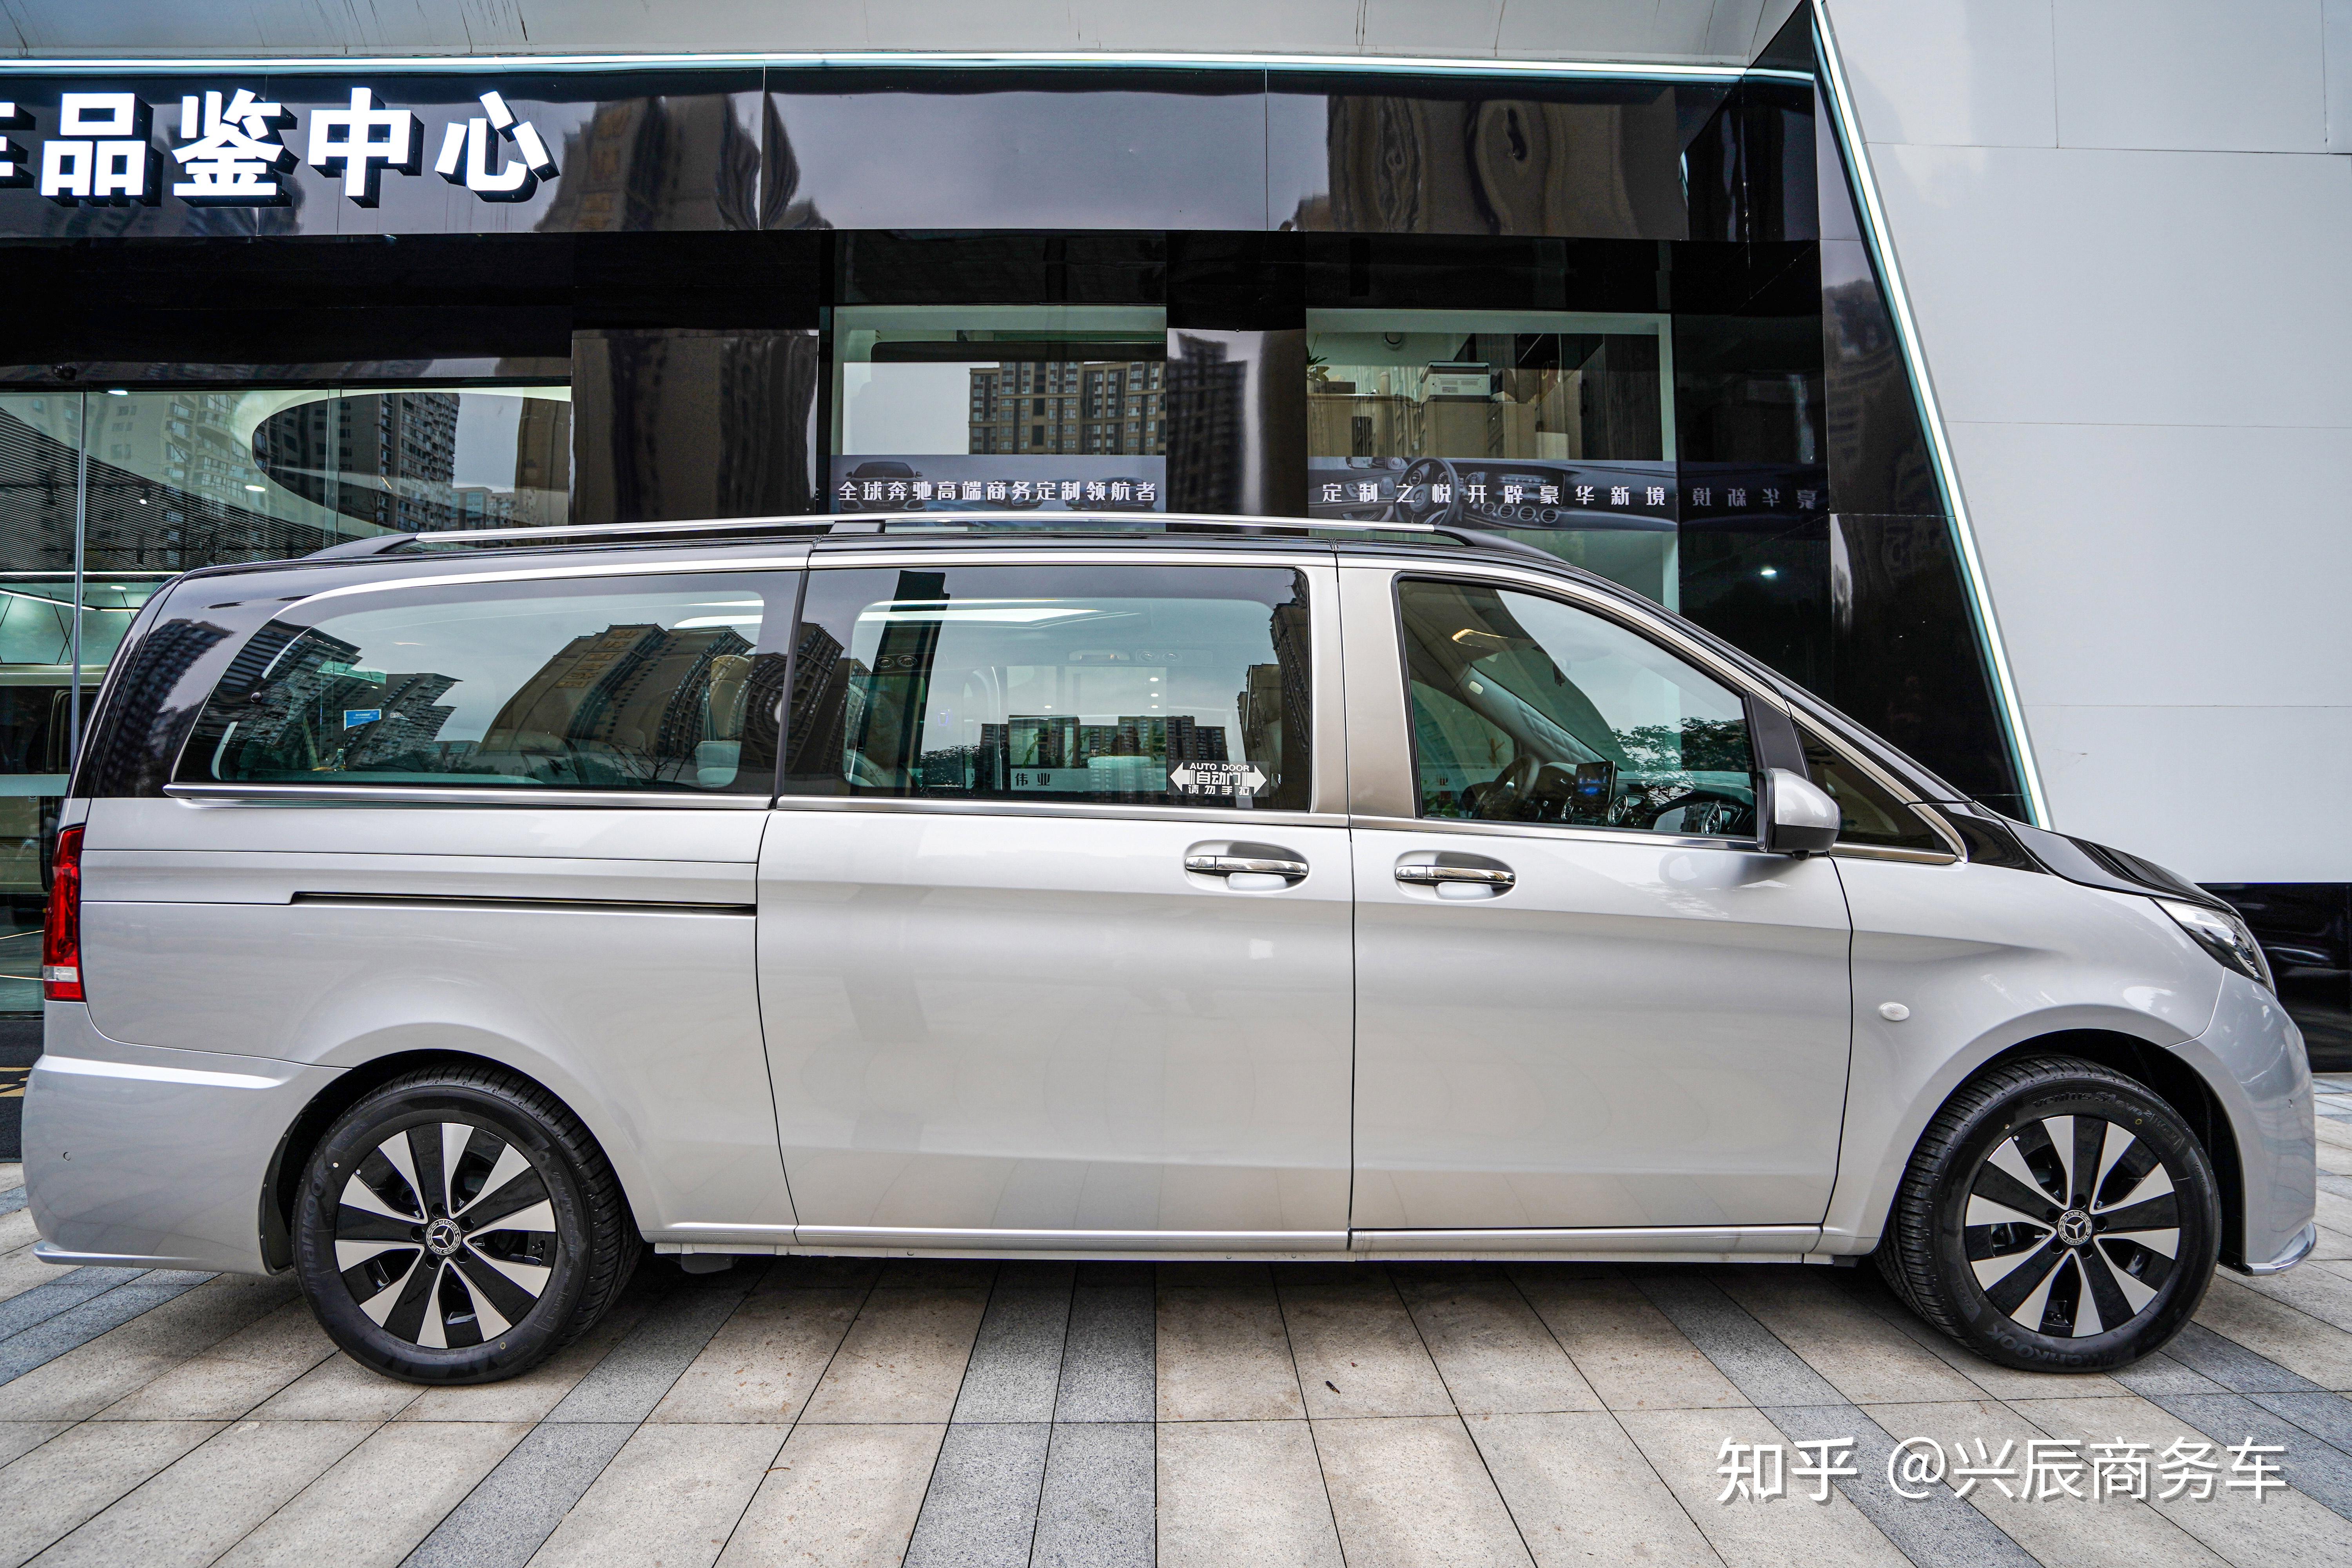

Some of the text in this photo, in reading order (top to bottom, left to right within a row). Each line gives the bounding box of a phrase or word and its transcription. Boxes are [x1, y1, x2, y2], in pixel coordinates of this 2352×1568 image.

[0, 87, 550, 196] 品鉴中心
[838, 481, 1156, 501] 全球奔驰高端商务定制领航者
[1322, 483, 1666, 506] 定制之悦开辟豪华新境
[1015, 773, 1050, 786] 伟业
[1196, 771, 1241, 785] 自动门
[1188, 784, 1250, 796] 请勿手拉
[438, 1220, 459, 1234] MERCEDES
[431, 1245, 443, 1254] BENZ
